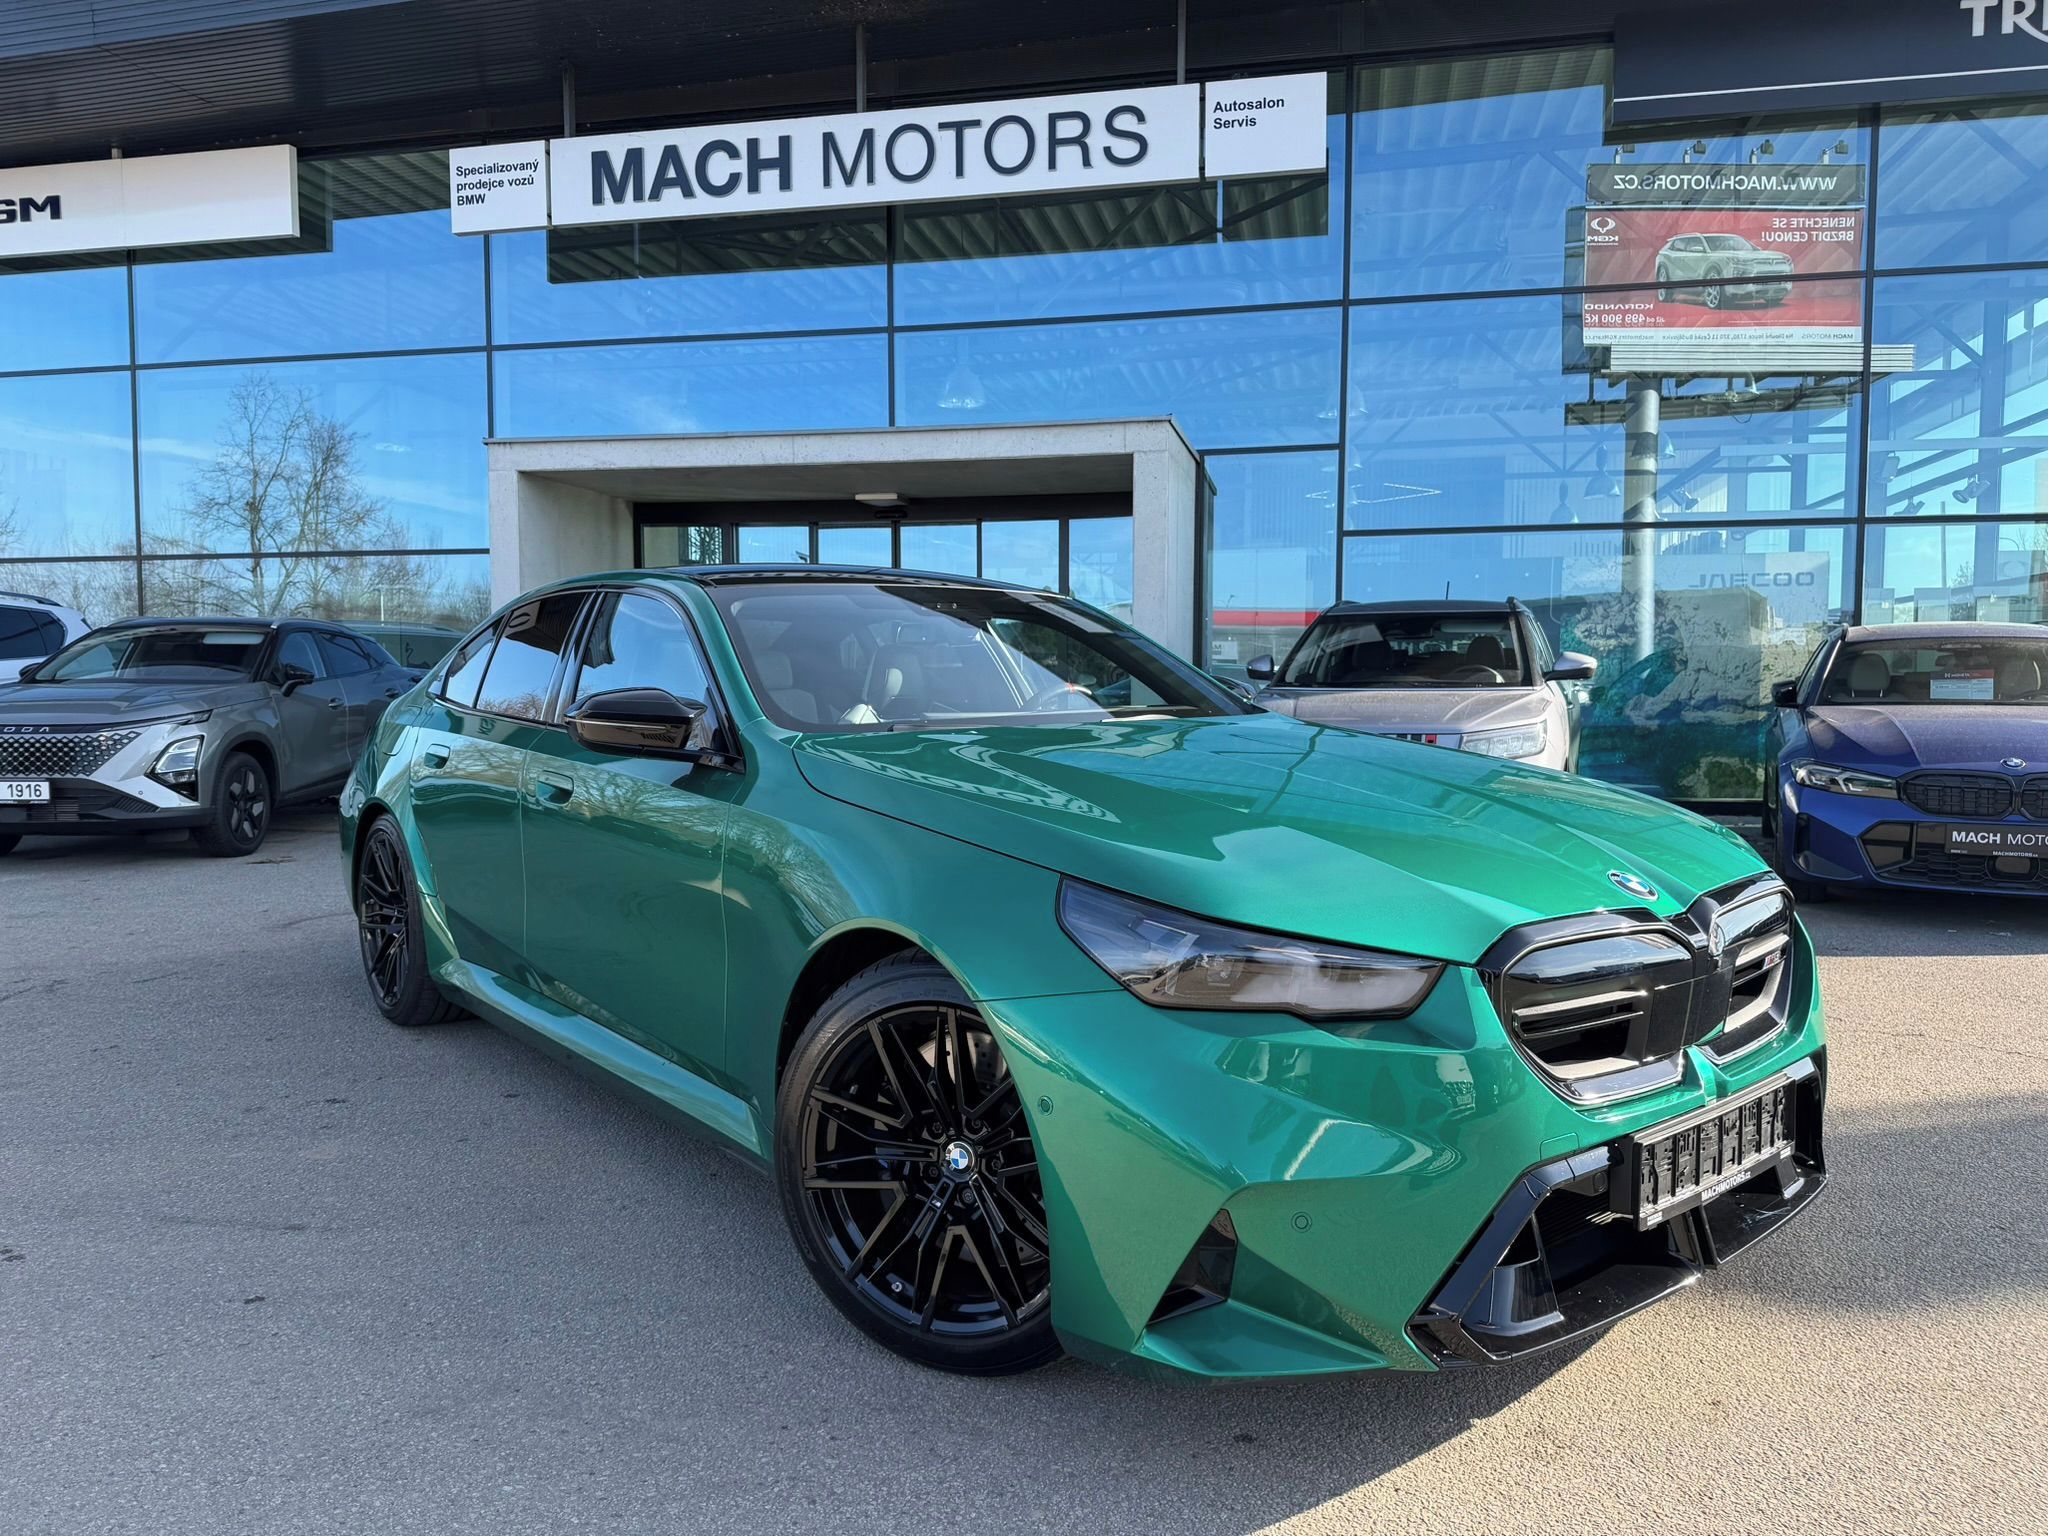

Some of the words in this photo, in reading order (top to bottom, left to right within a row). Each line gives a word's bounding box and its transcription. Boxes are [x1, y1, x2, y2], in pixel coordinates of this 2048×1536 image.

[1960, 0, 2048, 43] TR
[1213, 97, 1285, 113] Autosalon
[1213, 115, 1257, 130] Servis
[591, 134, 793, 206] MACH
[822, 105, 1149, 188] MOTORS
[456, 159, 539, 178] Specializovaný
[456, 179, 505, 194] prodejce
[507, 175, 534, 187] vozů
[457, 193, 486, 207] BMW
[1688, 572, 1815, 588] JAECOO
[7, 783, 42, 798] 1916
[1951, 830, 2001, 844] MACH
[2007, 833, 2048, 846] MOT
